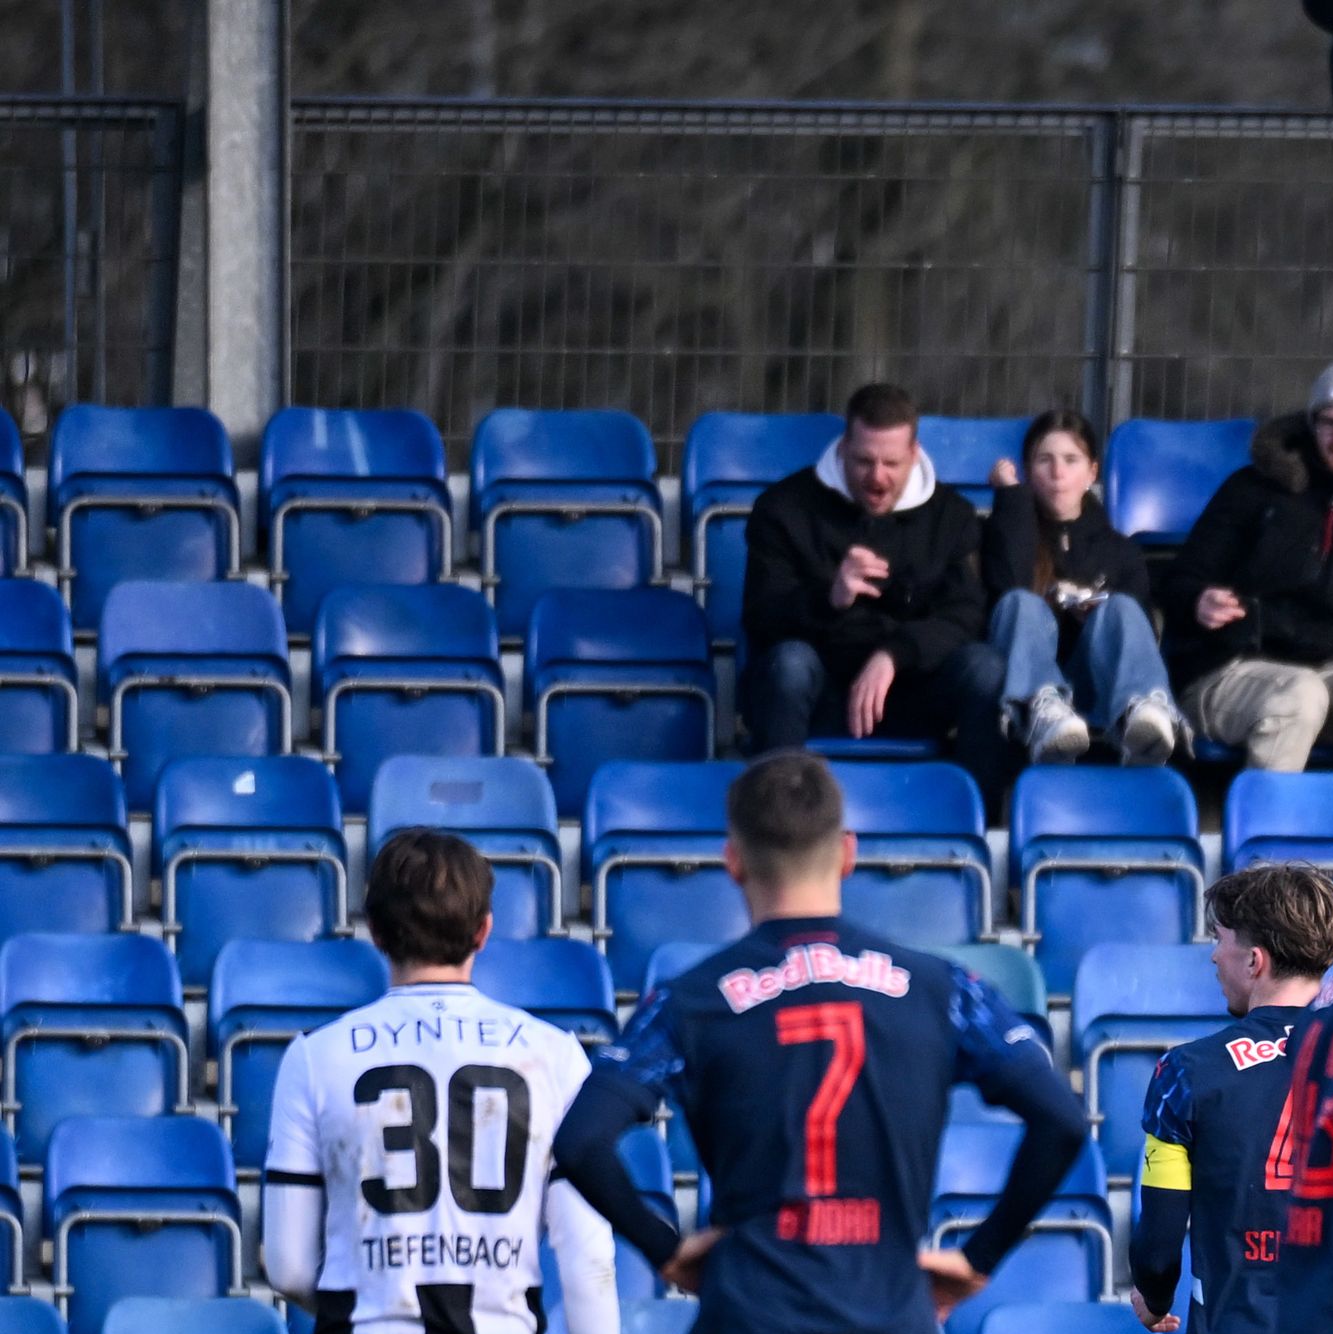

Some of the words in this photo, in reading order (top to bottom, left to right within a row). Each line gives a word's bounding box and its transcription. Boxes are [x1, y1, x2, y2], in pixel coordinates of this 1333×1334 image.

[351, 1016, 529, 1053] DYNTEX
[353, 1064, 530, 1214] 30
[775, 1002, 865, 1198] 7
[361, 1234, 523, 1271] TIEFENBACH
